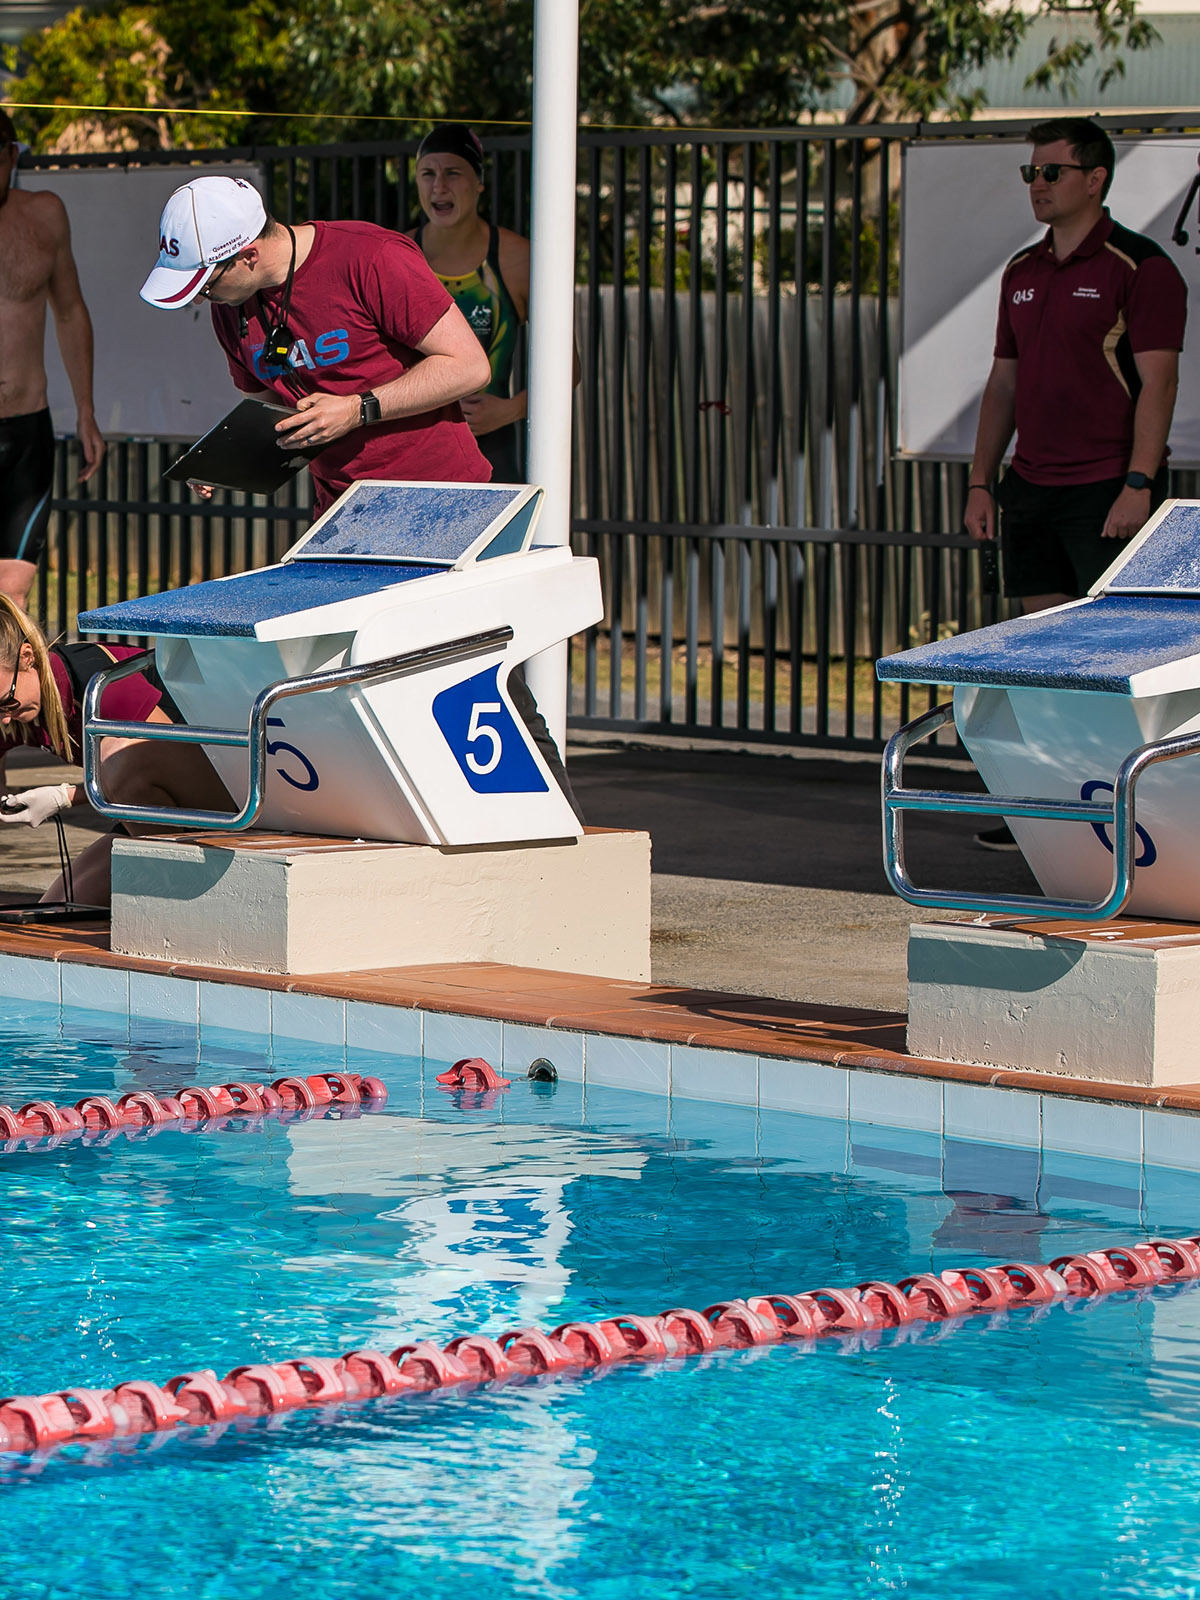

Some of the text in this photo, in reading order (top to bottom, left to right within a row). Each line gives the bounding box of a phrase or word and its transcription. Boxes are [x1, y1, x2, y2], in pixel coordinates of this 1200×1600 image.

[208, 249, 231, 262] Academy
[237, 236, 250, 248] Sport
[212, 234, 242, 253] Queensland
[1012, 288, 1035, 305] QAS
[465, 702, 502, 775] 5
[266, 717, 319, 791] 5
